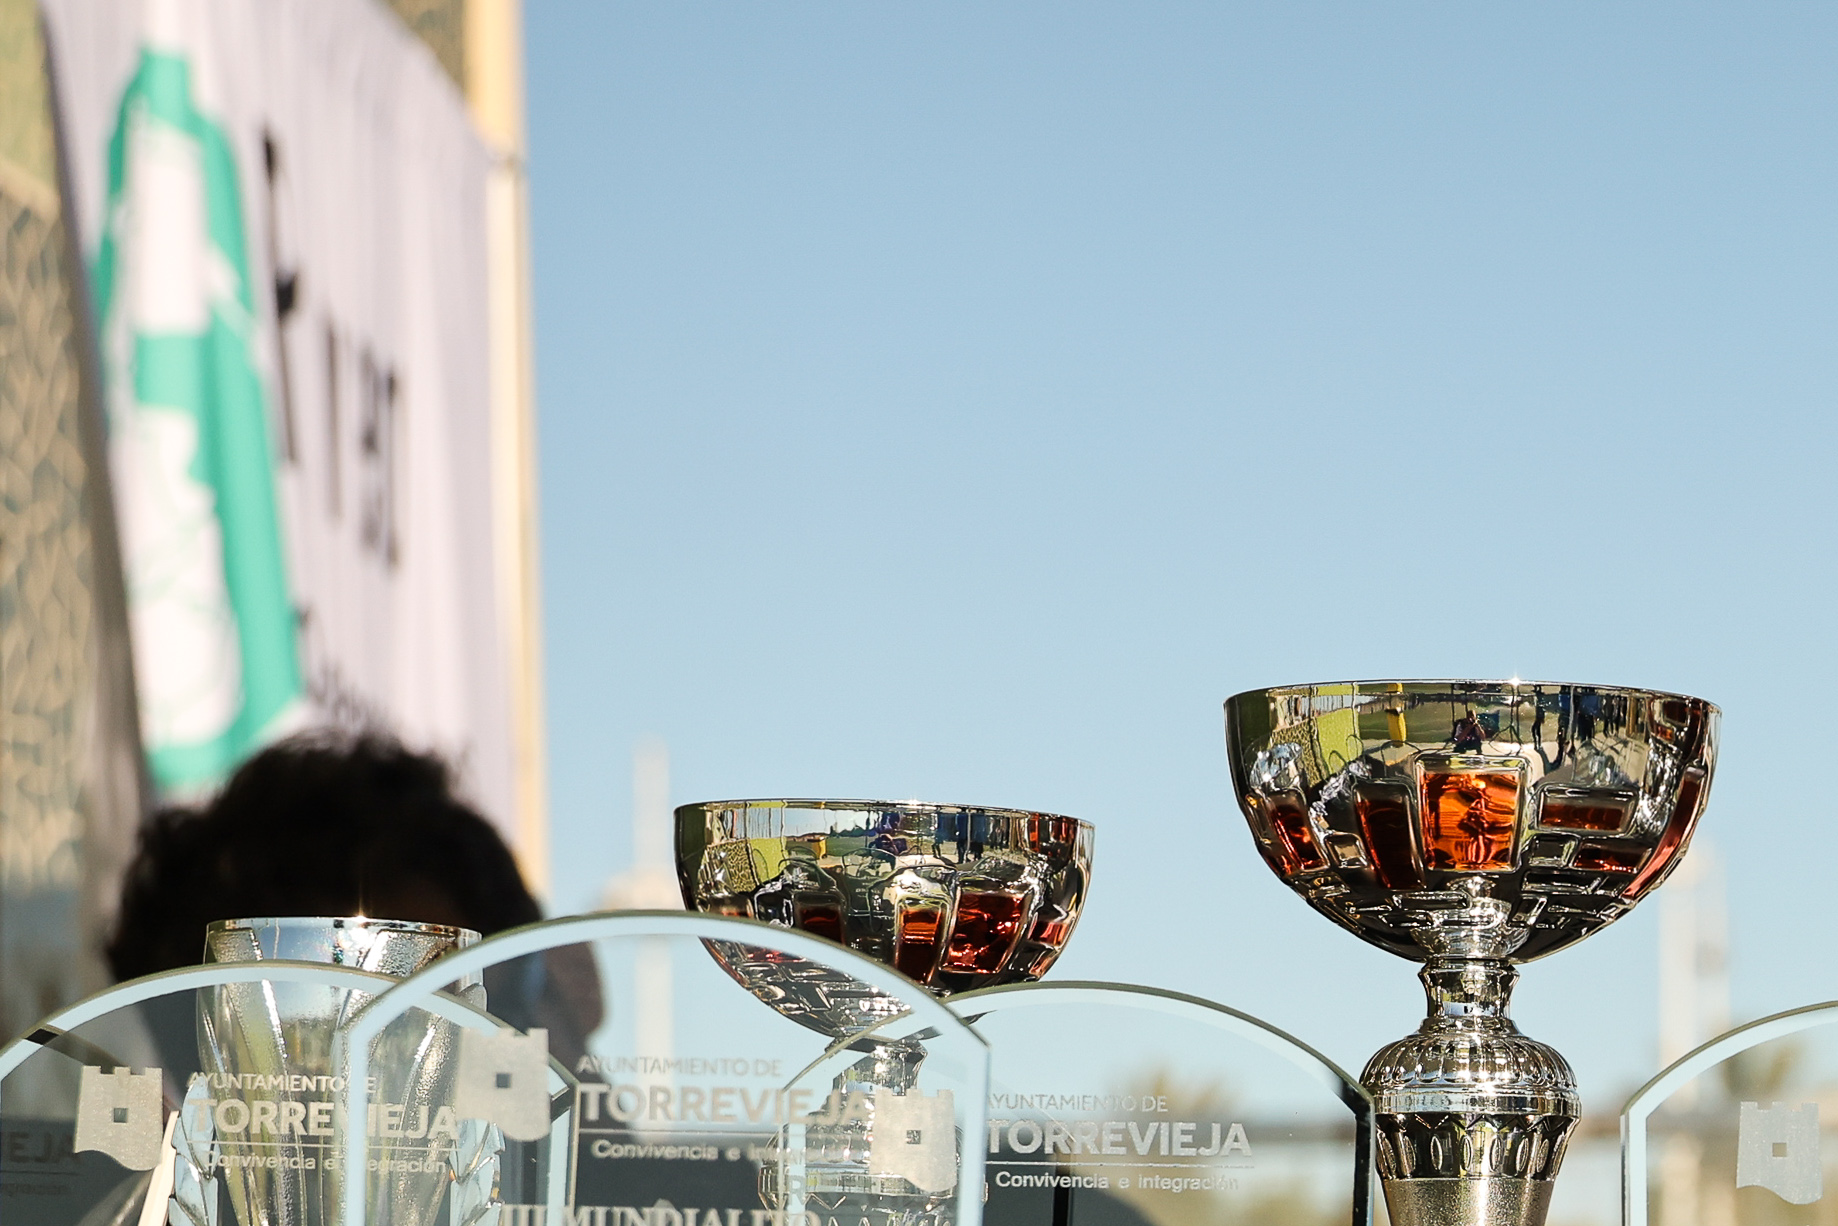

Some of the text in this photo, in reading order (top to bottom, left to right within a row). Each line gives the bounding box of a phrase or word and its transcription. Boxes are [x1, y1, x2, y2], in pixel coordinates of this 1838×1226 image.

[576, 1053, 784, 1078] AYUNTAMIENTO DE
[187, 1071, 345, 1093] AYUNTAMIENTO
[579, 1082, 874, 1127] TORREVIEJA
[986, 1093, 1168, 1113] AYUNTAMIENTO DE
[187, 1098, 459, 1140] TORREIEJA
[986, 1119, 1253, 1158] TORREVIEJA
[591, 1139, 719, 1161] Convivencia
[724, 1145, 741, 1161] e
[343, 1160, 446, 1175] egración
[995, 1171, 1238, 1192] Convivencia e integración
